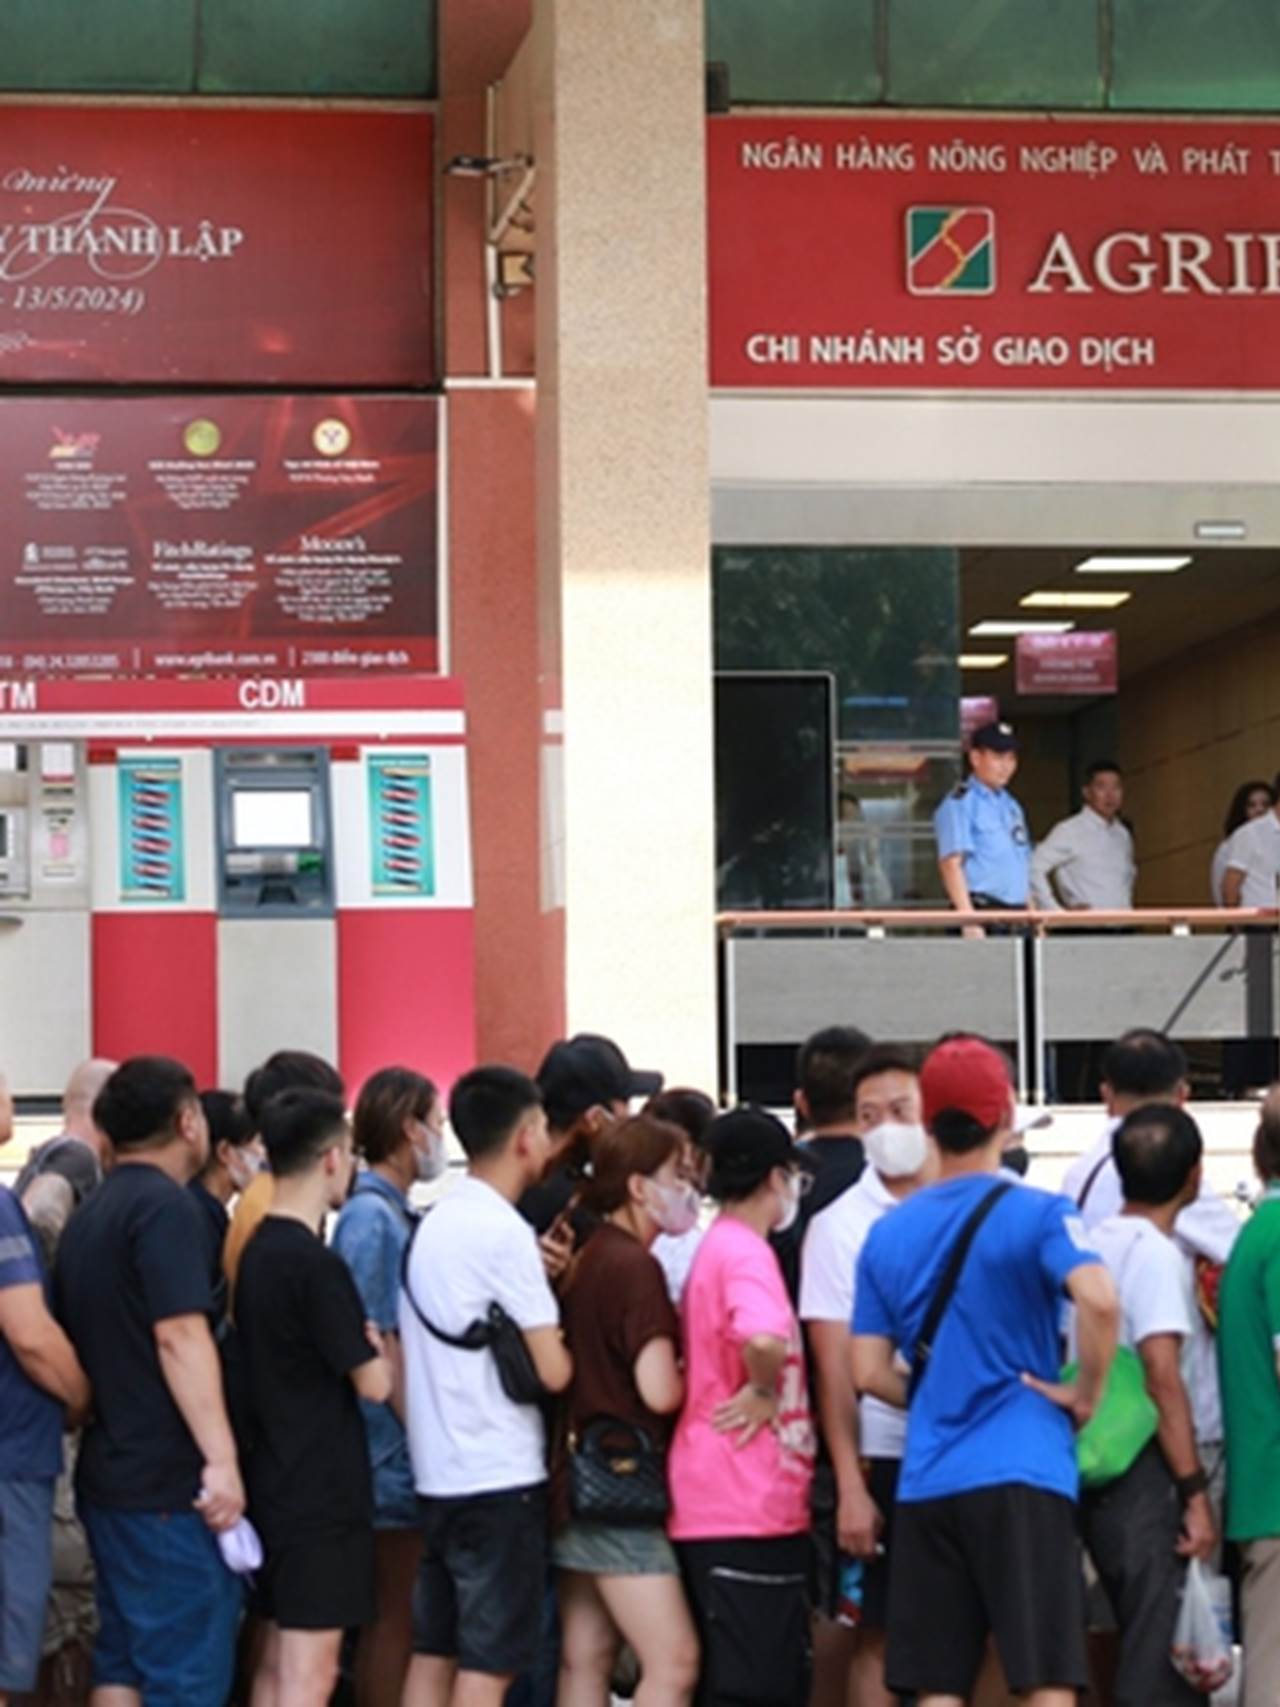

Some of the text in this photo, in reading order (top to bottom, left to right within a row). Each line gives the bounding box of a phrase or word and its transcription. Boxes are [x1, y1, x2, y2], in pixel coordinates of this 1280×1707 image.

[742, 136, 822, 169] NGÂN
[837, 137, 914, 171] HÀNG
[929, 139, 1007, 172] NÔNG
[1021, 141, 1118, 179] NGHIỆP
[1134, 142, 1168, 174] VÀ
[1183, 143, 1250, 175] PHÁT
[169, 219, 243, 262] LẬP
[13, 286, 145, 315] 13/5/2024)
[746, 325, 1154, 373] CHI NHÁNH SỞ GIAO DỊCH
[239, 679, 305, 708] CDM
